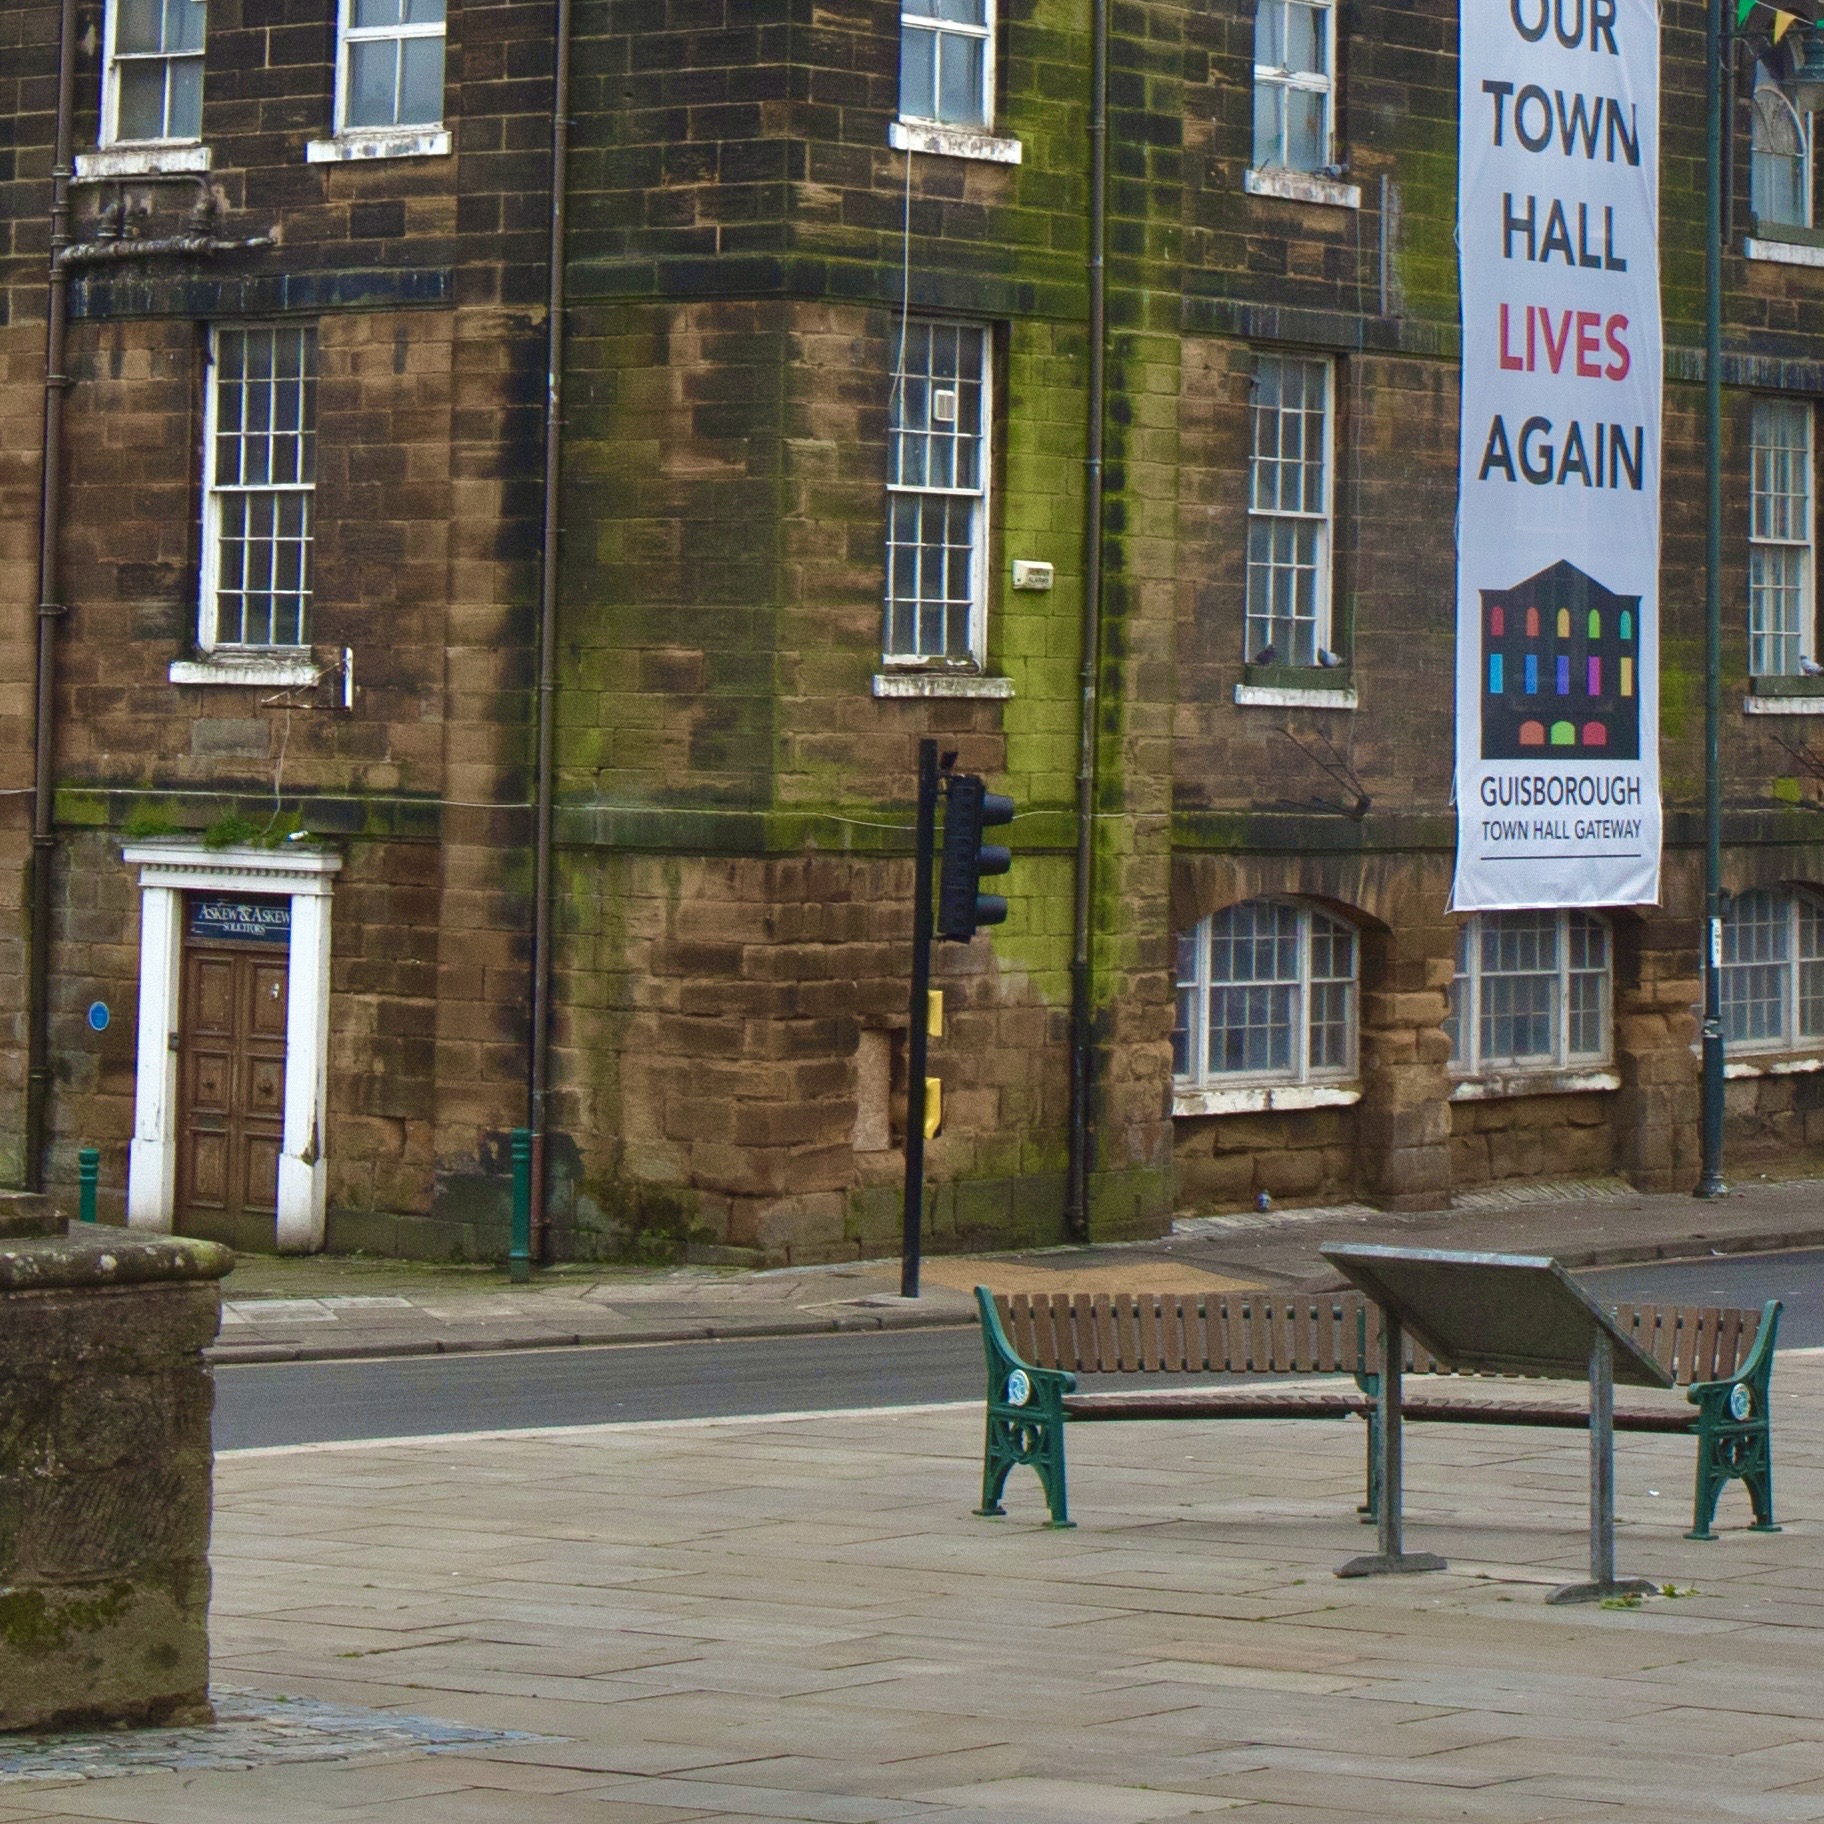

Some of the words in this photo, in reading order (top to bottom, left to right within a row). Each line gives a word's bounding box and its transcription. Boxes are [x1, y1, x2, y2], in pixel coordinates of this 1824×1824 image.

[1482, 79, 1640, 166] TOWN
[1503, 192, 1627, 272] HALL
[1499, 303, 1630, 382] LIVES
[1478, 414, 1643, 491] AGAIN
[1480, 776, 1641, 807] GUISBOROUGH
[1482, 820, 1528, 841] TOWN
[1533, 820, 1570, 840] HALL
[1574, 819, 1642, 840] GATEWAY
